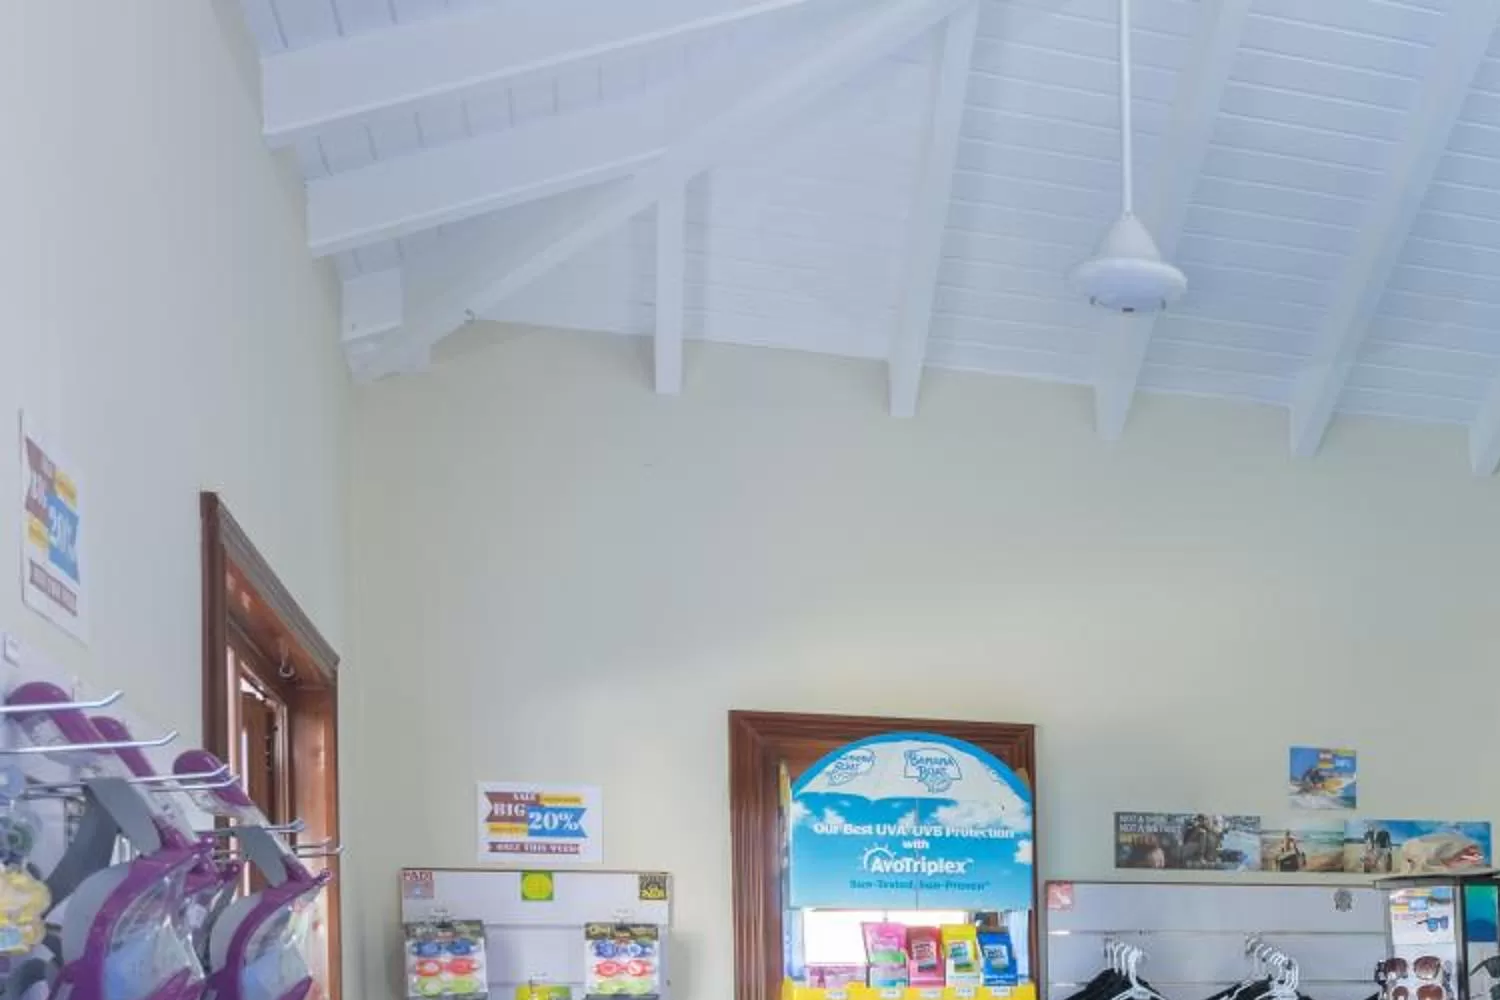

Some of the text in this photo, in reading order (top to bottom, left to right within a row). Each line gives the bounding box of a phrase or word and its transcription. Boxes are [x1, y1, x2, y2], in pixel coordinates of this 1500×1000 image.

[493, 803, 526, 817] BIG
[528, 811, 580, 831] 20%
[813, 823, 839, 835] Our
[843, 824, 873, 836] Best
[946, 826, 1015, 840] Protection
[902, 839, 930, 850] with
